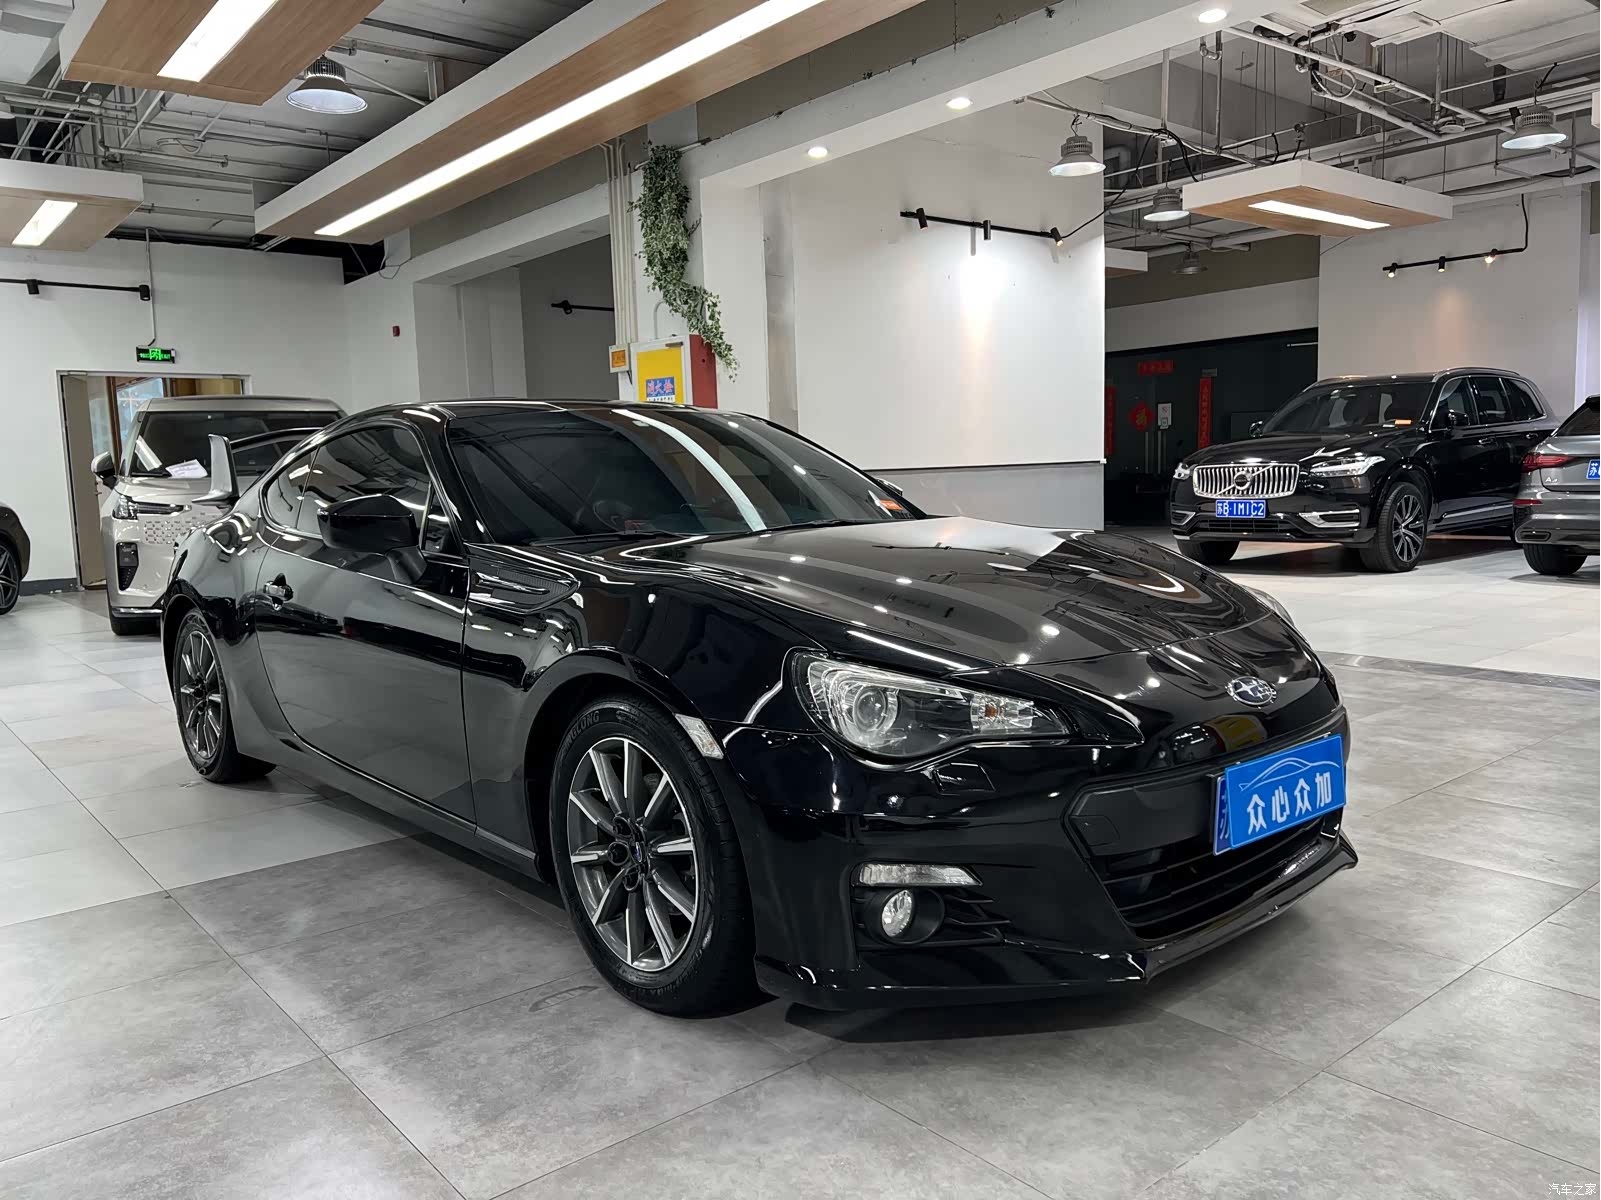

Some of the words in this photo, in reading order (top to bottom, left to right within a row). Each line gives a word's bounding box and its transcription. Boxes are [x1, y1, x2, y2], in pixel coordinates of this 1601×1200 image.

[1588, 462, 1600, 477] 苏
[1246, 771, 1332, 835] 众心众加
